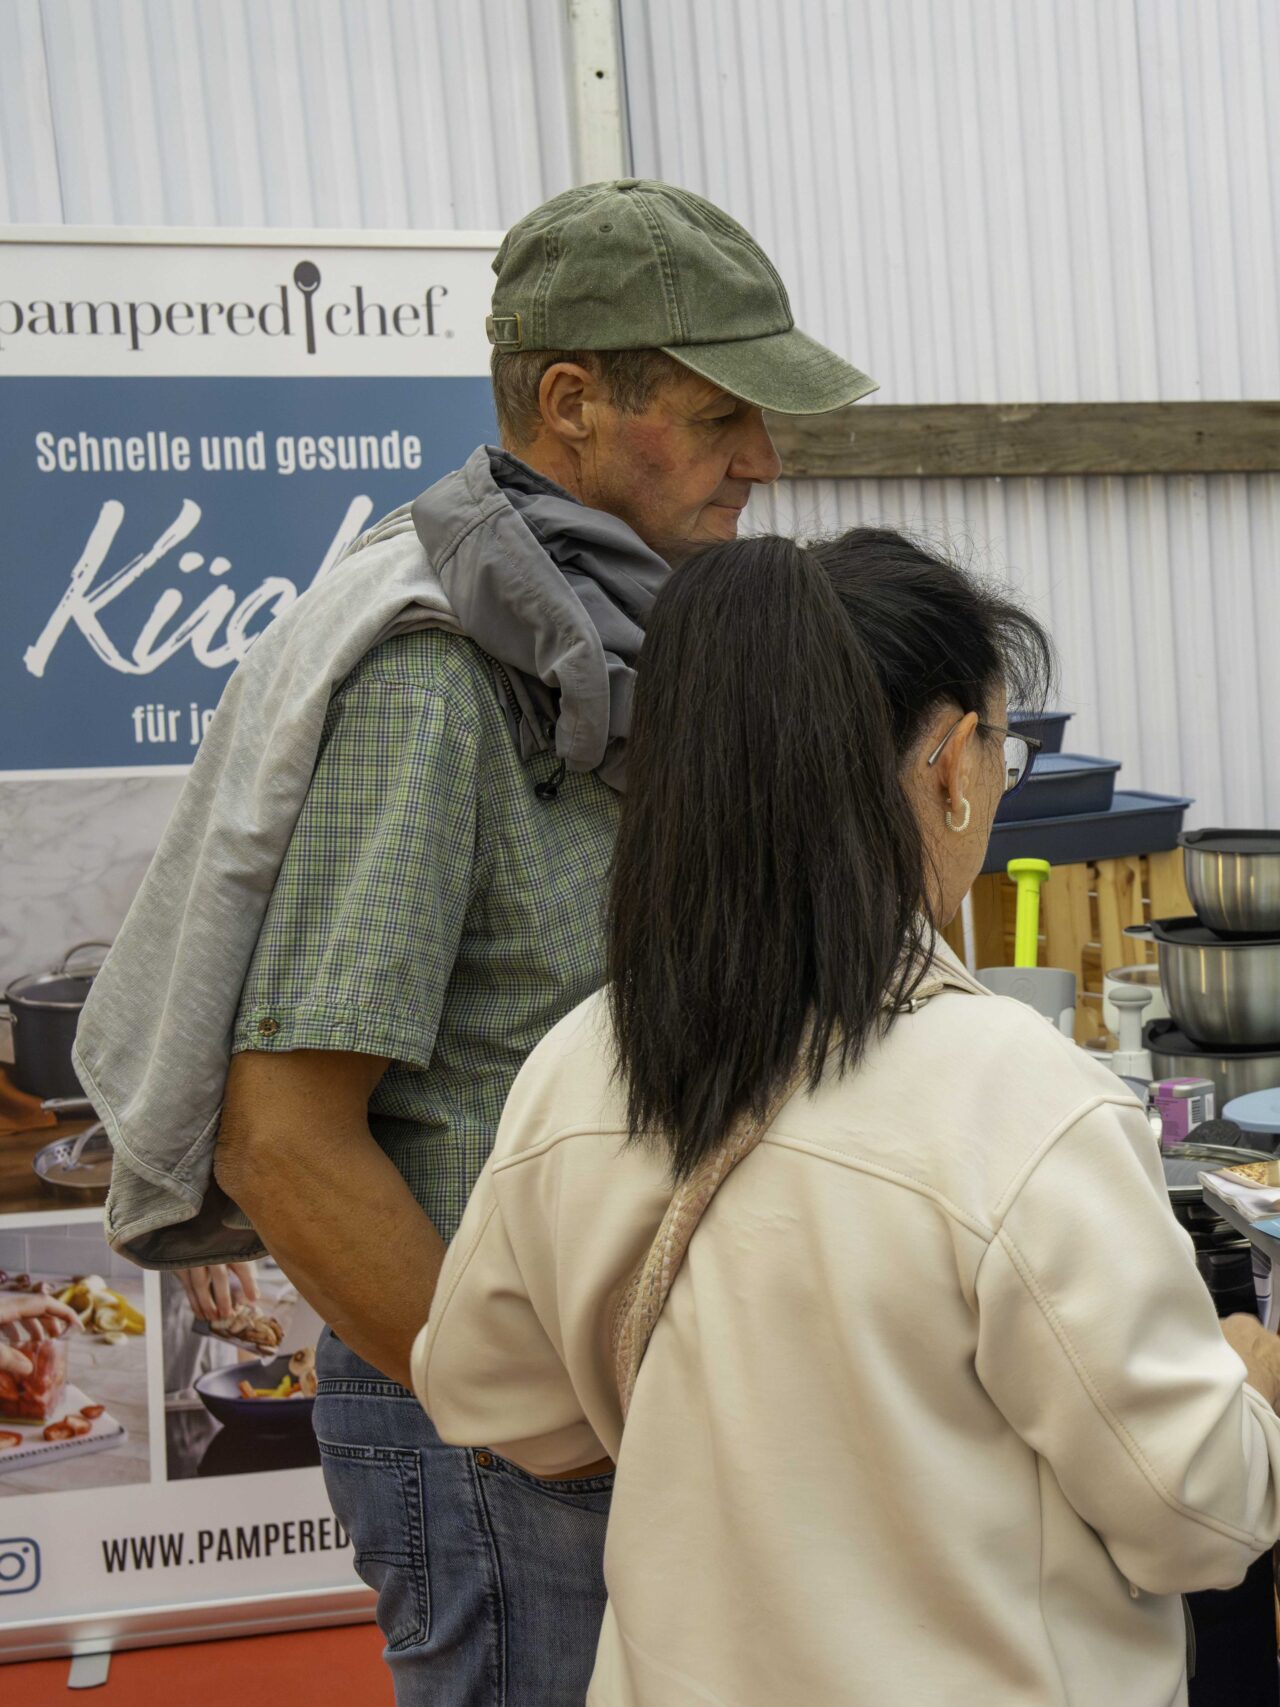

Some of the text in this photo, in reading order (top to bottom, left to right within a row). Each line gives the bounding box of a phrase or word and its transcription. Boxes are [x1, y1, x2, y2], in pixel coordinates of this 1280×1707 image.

[0, 284, 294, 351] pampered
[36, 430, 422, 474] Schnelle und gesunde
[131, 703, 181, 743] für
[102, 1517, 350, 1573] WWW.PAMPERED
